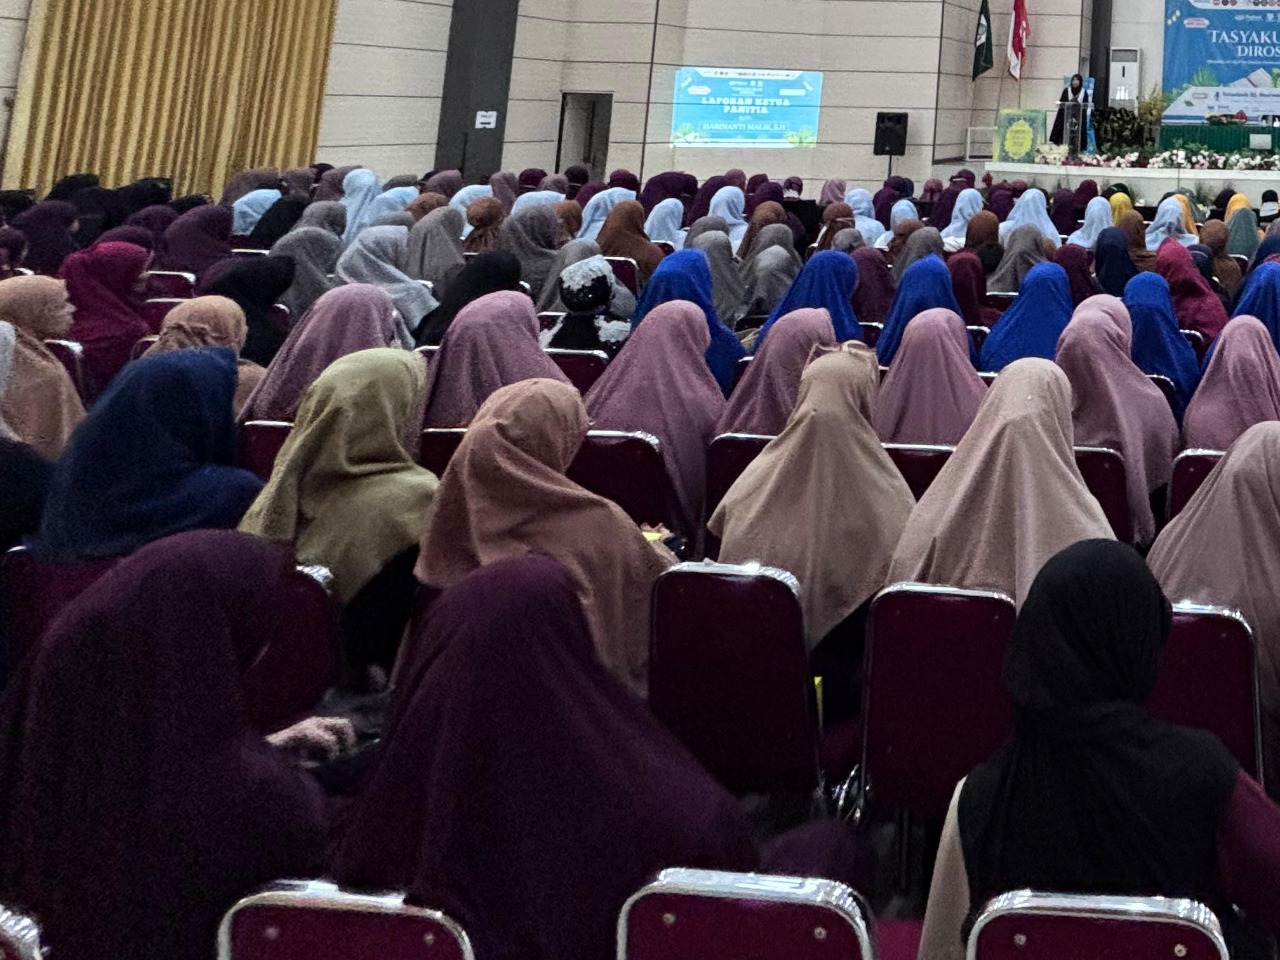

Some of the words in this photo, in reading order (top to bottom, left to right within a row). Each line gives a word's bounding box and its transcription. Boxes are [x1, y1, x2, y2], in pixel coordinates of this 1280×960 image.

[701, 96, 753, 105] LAPORAN
[755, 98, 791, 106] KETUA
[724, 105, 768, 114] PANITIA
